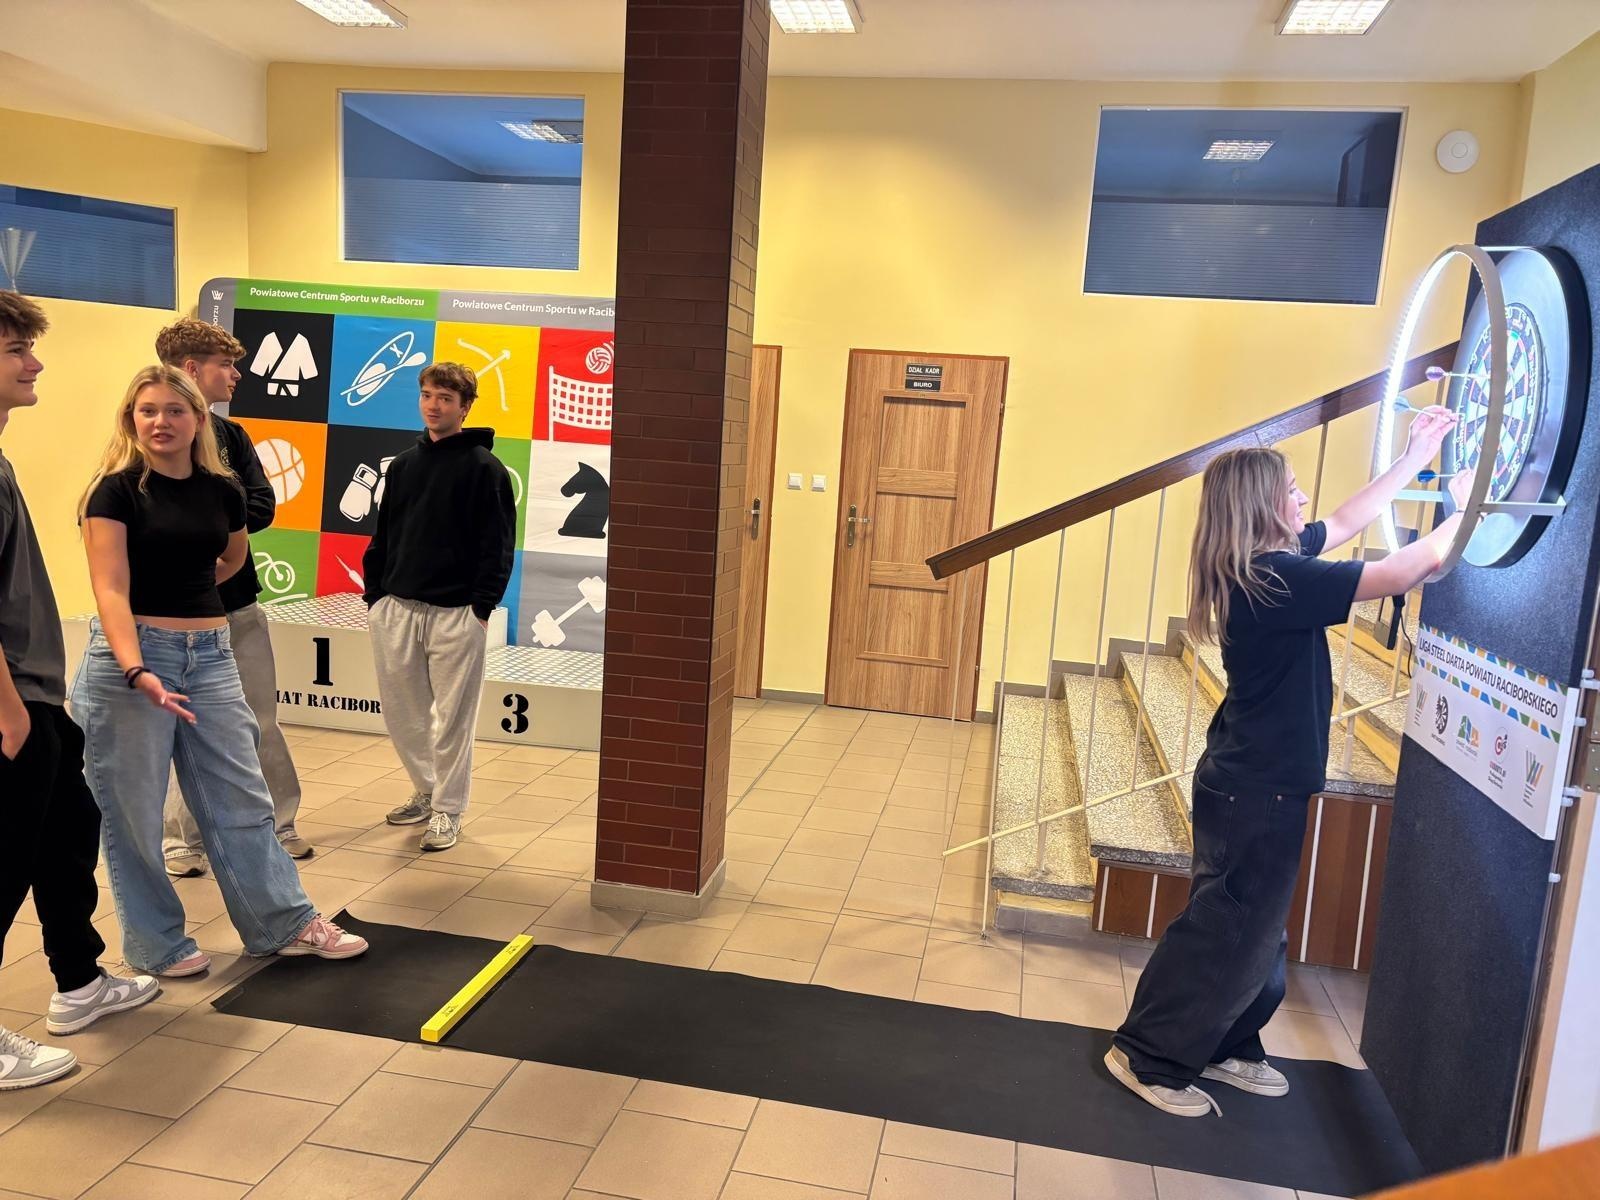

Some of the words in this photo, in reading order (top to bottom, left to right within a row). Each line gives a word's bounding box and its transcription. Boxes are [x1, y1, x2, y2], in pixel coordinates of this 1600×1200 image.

[249, 287, 299, 299] Powiatowe
[300, 290, 339, 301] Centrum
[339, 292, 370, 304] Sportu
[370, 296, 380, 304] w
[380, 295, 425, 307] Raciborzu
[452, 299, 503, 311] Powiatowe
[503, 301, 544, 313] Centrum
[545, 304, 577, 316] Sportu
[578, 308, 588, 316] w
[313, 637, 333, 686] 1
[1419, 637, 1432, 655] LIGA
[1430, 643, 1446, 663] STEEL
[1445, 652, 1465, 672] DARTA
[1465, 661, 1498, 688] POWIATU
[1496, 676, 1559, 719] RACIBORSKIEGO
[501, 693, 529, 734] 3
